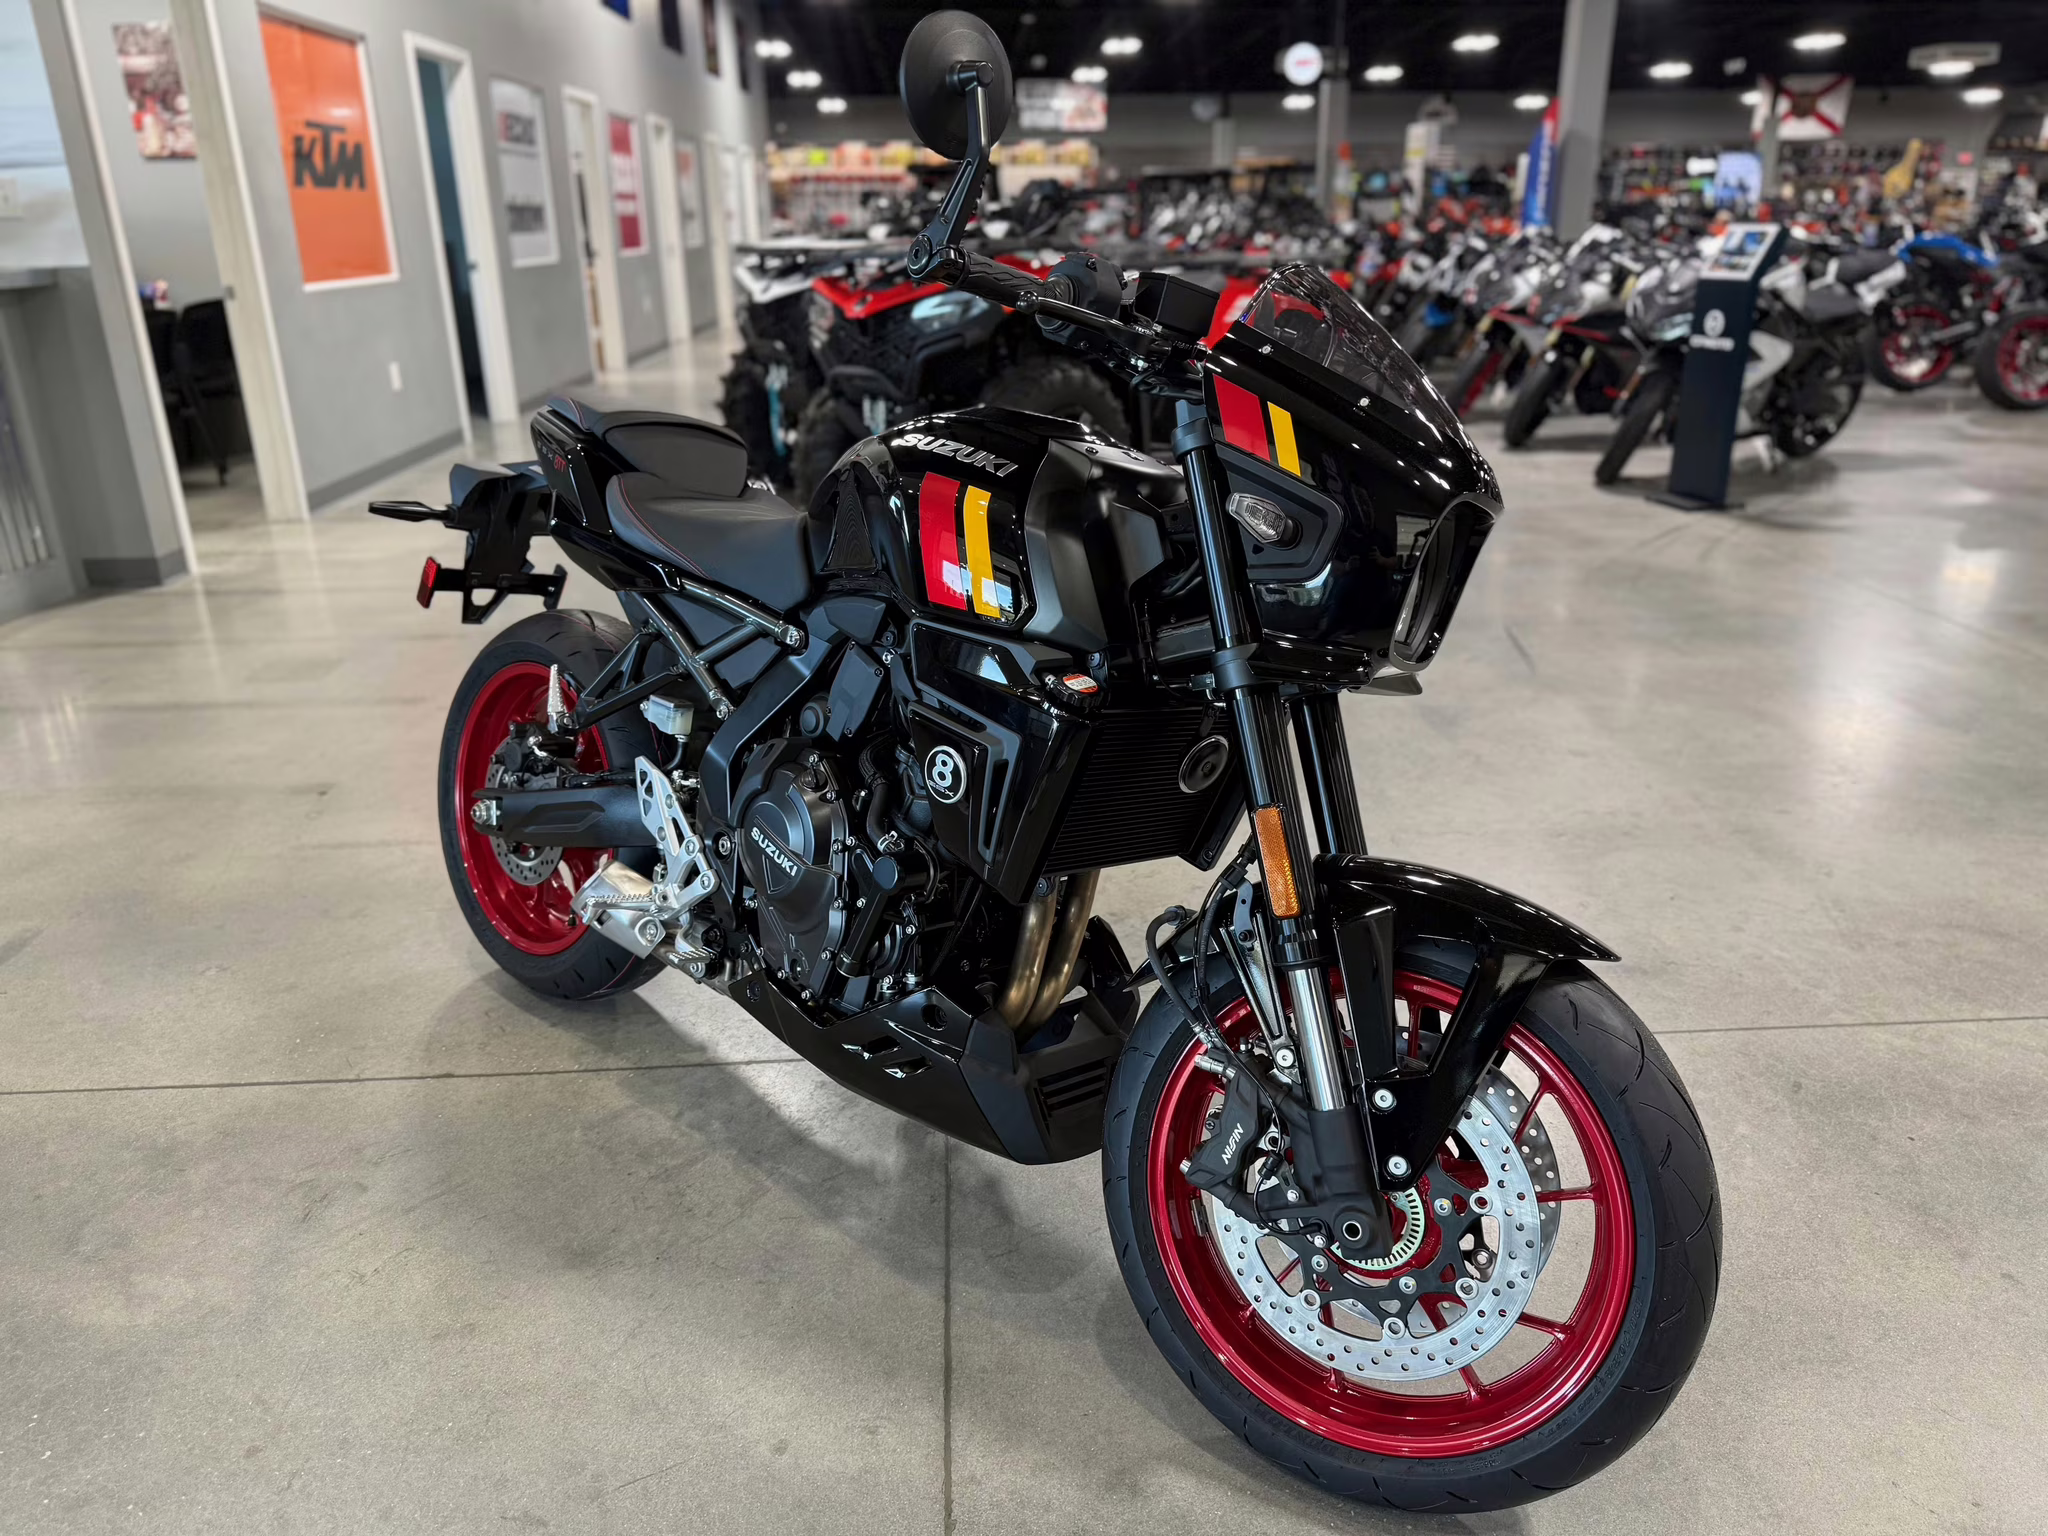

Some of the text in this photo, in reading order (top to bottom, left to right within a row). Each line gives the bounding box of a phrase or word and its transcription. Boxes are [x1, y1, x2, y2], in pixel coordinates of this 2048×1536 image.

[292, 119, 367, 191] KTM
[893, 433, 1019, 477] SUZUKI
[932, 753, 954, 788] 8
[750, 826, 798, 877] SUZUKI
[1221, 1122, 1244, 1165] NISSIN
